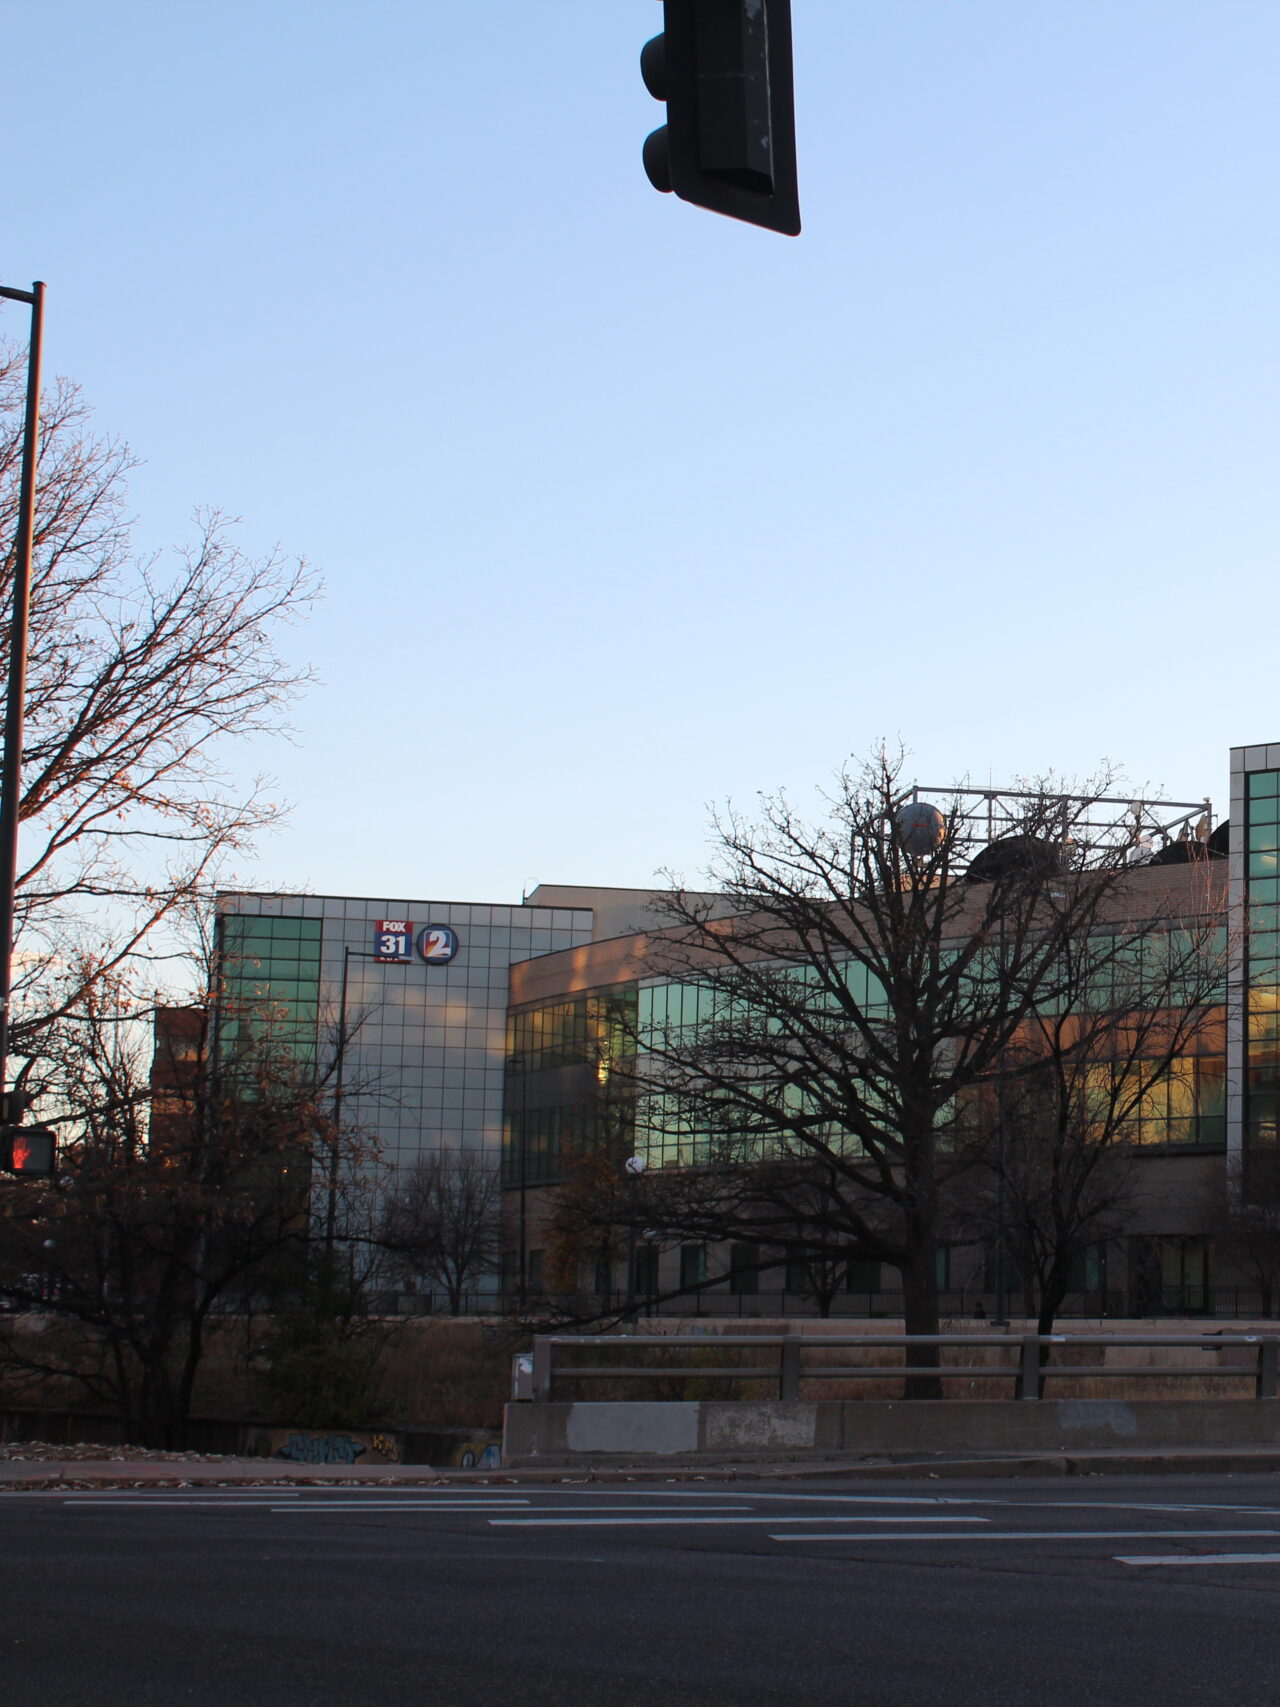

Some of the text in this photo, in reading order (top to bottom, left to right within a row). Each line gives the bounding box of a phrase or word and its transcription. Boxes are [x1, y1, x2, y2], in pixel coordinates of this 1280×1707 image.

[382, 921, 406, 932] FOX
[380, 935, 406, 954] 31
[428, 931, 451, 956] 2
